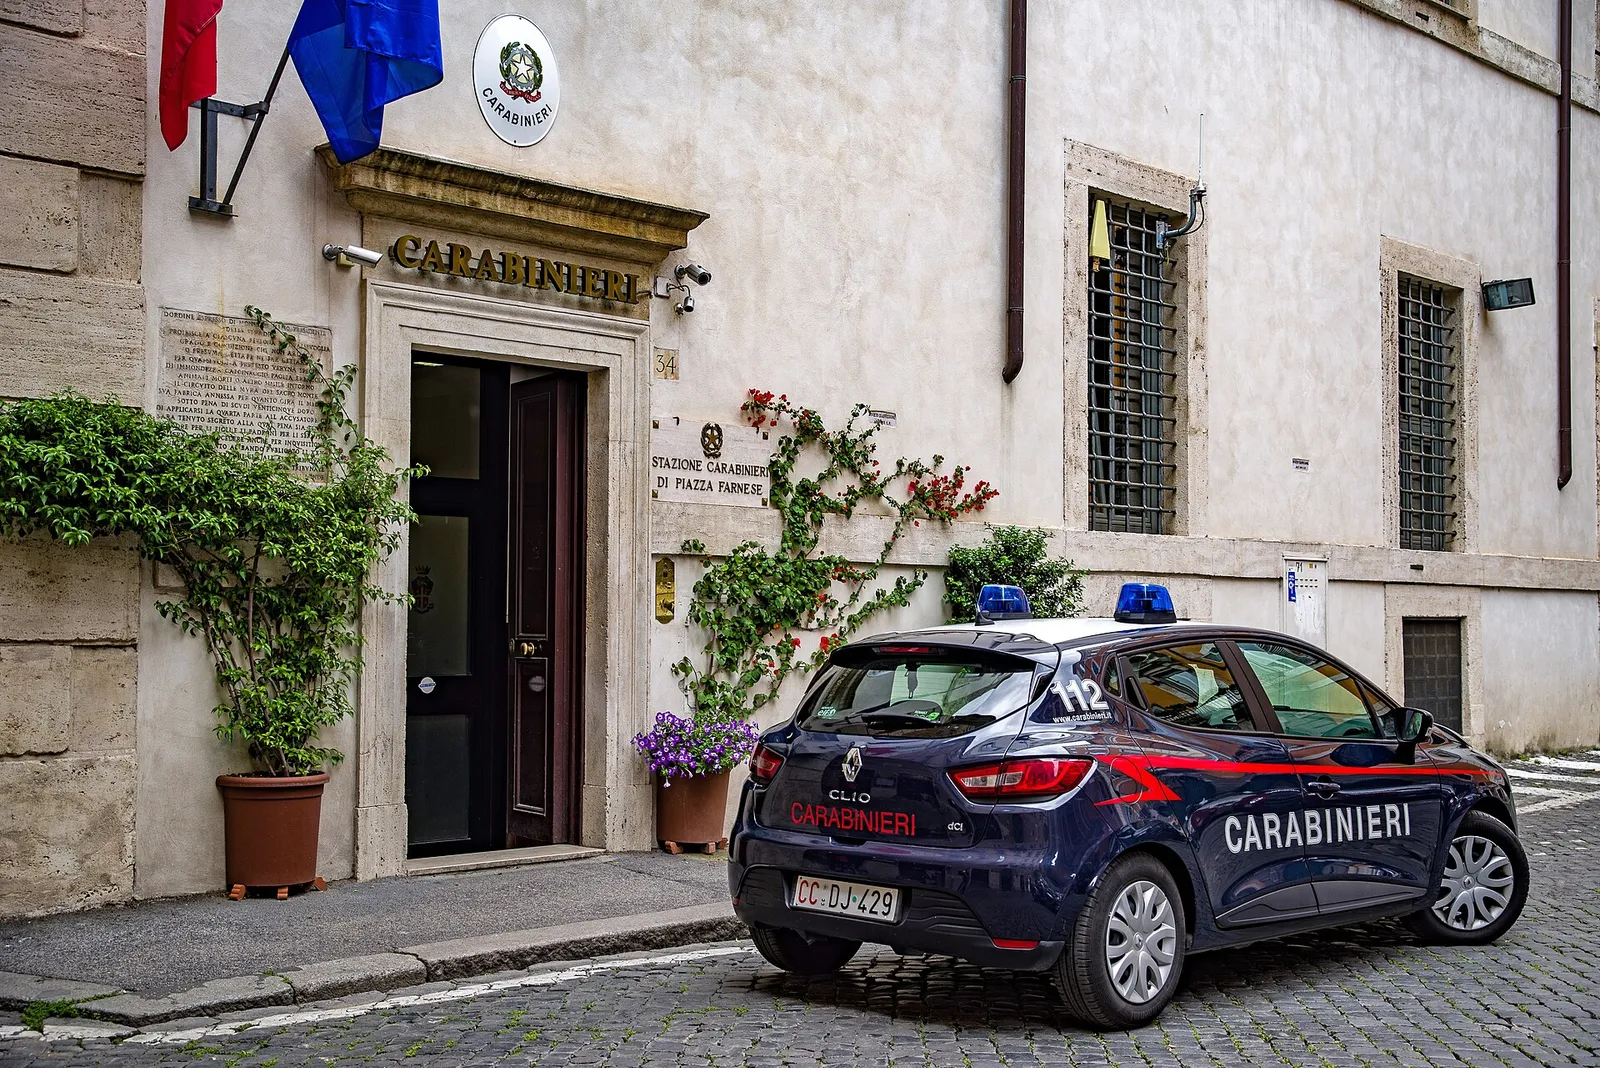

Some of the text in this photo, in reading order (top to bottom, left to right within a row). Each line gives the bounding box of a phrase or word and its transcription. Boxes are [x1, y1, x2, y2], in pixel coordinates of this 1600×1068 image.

[482, 87, 552, 127] CARABINIERI
[393, 234, 639, 304] CARABINIERI
[656, 354, 676, 374] 34
[174, 389, 202, 398] FABRICA
[204, 392, 234, 400] ANNESSA
[184, 382, 216, 390] CIRCVITO
[166, 405, 203, 414] APPLICARSI
[216, 410, 241, 418] QVARTA
[280, 415, 318, 424] ACCVSATORE
[178, 414, 205, 422] TENVTO
[207, 417, 235, 425] SEGRETO
[252, 404, 295, 415] VENTICINQVE
[292, 464, 324, 472] TRIBVNAE
[652, 456, 769, 478] STAZIONE CARABINIERI
[657, 476, 764, 496] DI PIAZZA FARNESE
[1050, 678, 1109, 712] 112
[1052, 712, 1112, 724] www.carabinieri.it
[829, 789, 871, 804] CLIO
[790, 802, 916, 836] CARABINIERI
[1224, 803, 1410, 854] CARABINIERI
[798, 879, 894, 917] CC DJ 429
